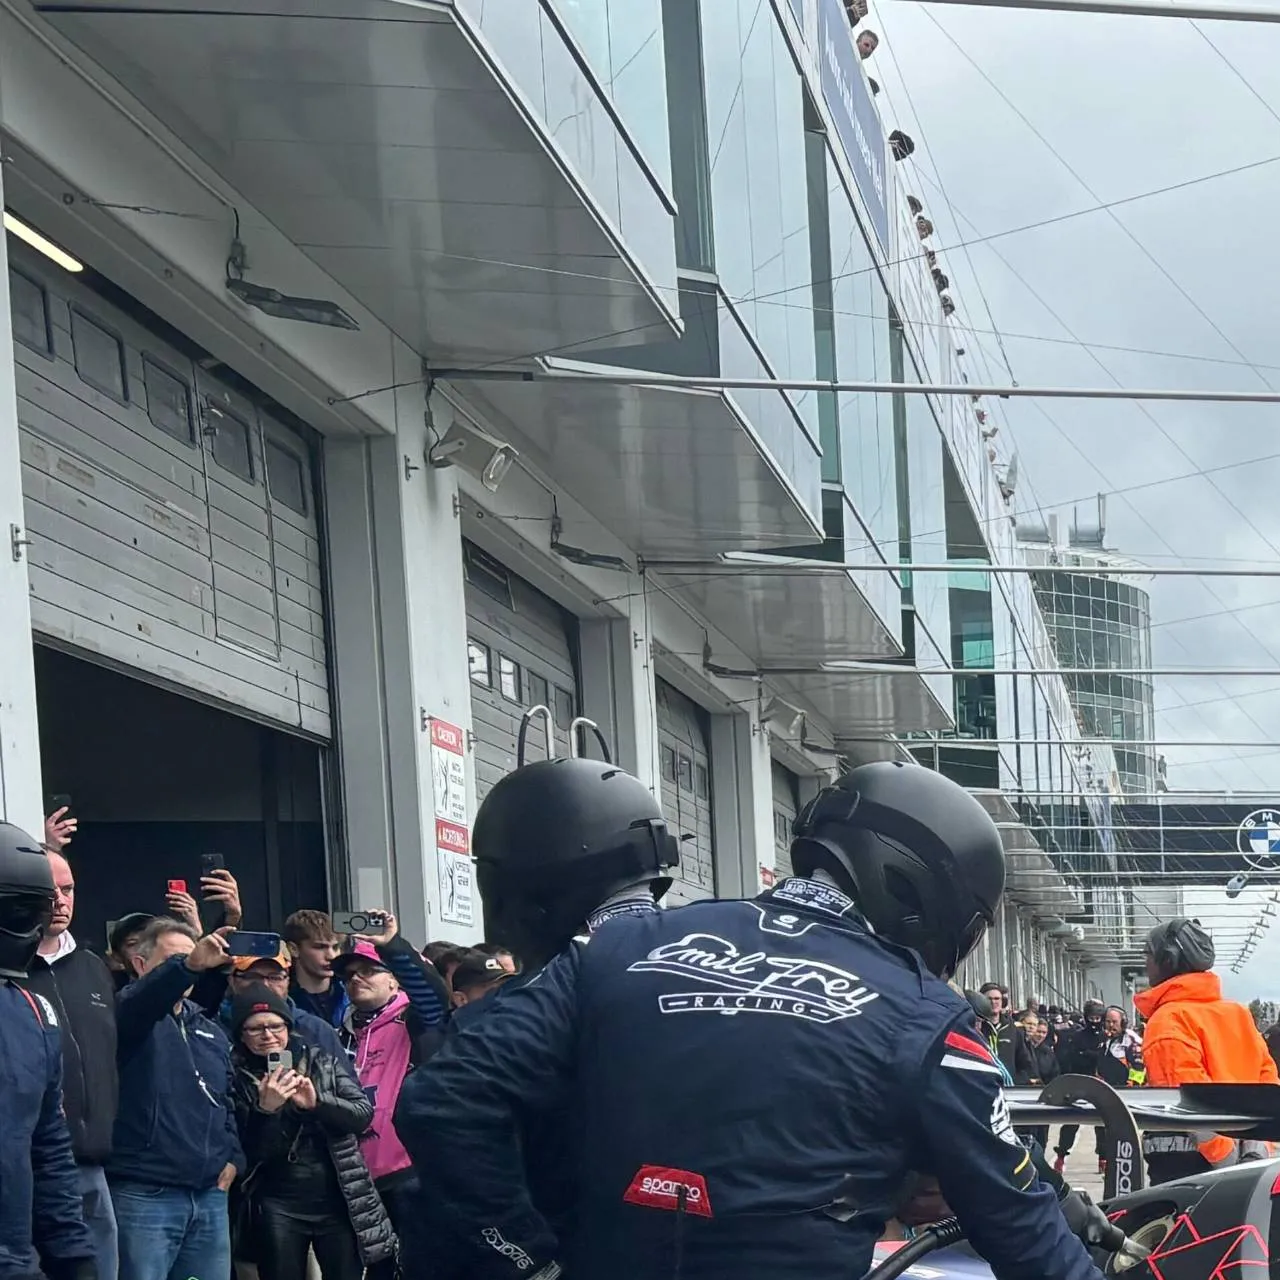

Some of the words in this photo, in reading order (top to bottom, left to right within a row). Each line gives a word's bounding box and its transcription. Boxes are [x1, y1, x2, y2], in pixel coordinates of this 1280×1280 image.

[647, 932, 756, 983] Emil
[750, 956, 880, 1013] Frey
[692, 995, 806, 1015] RACING
